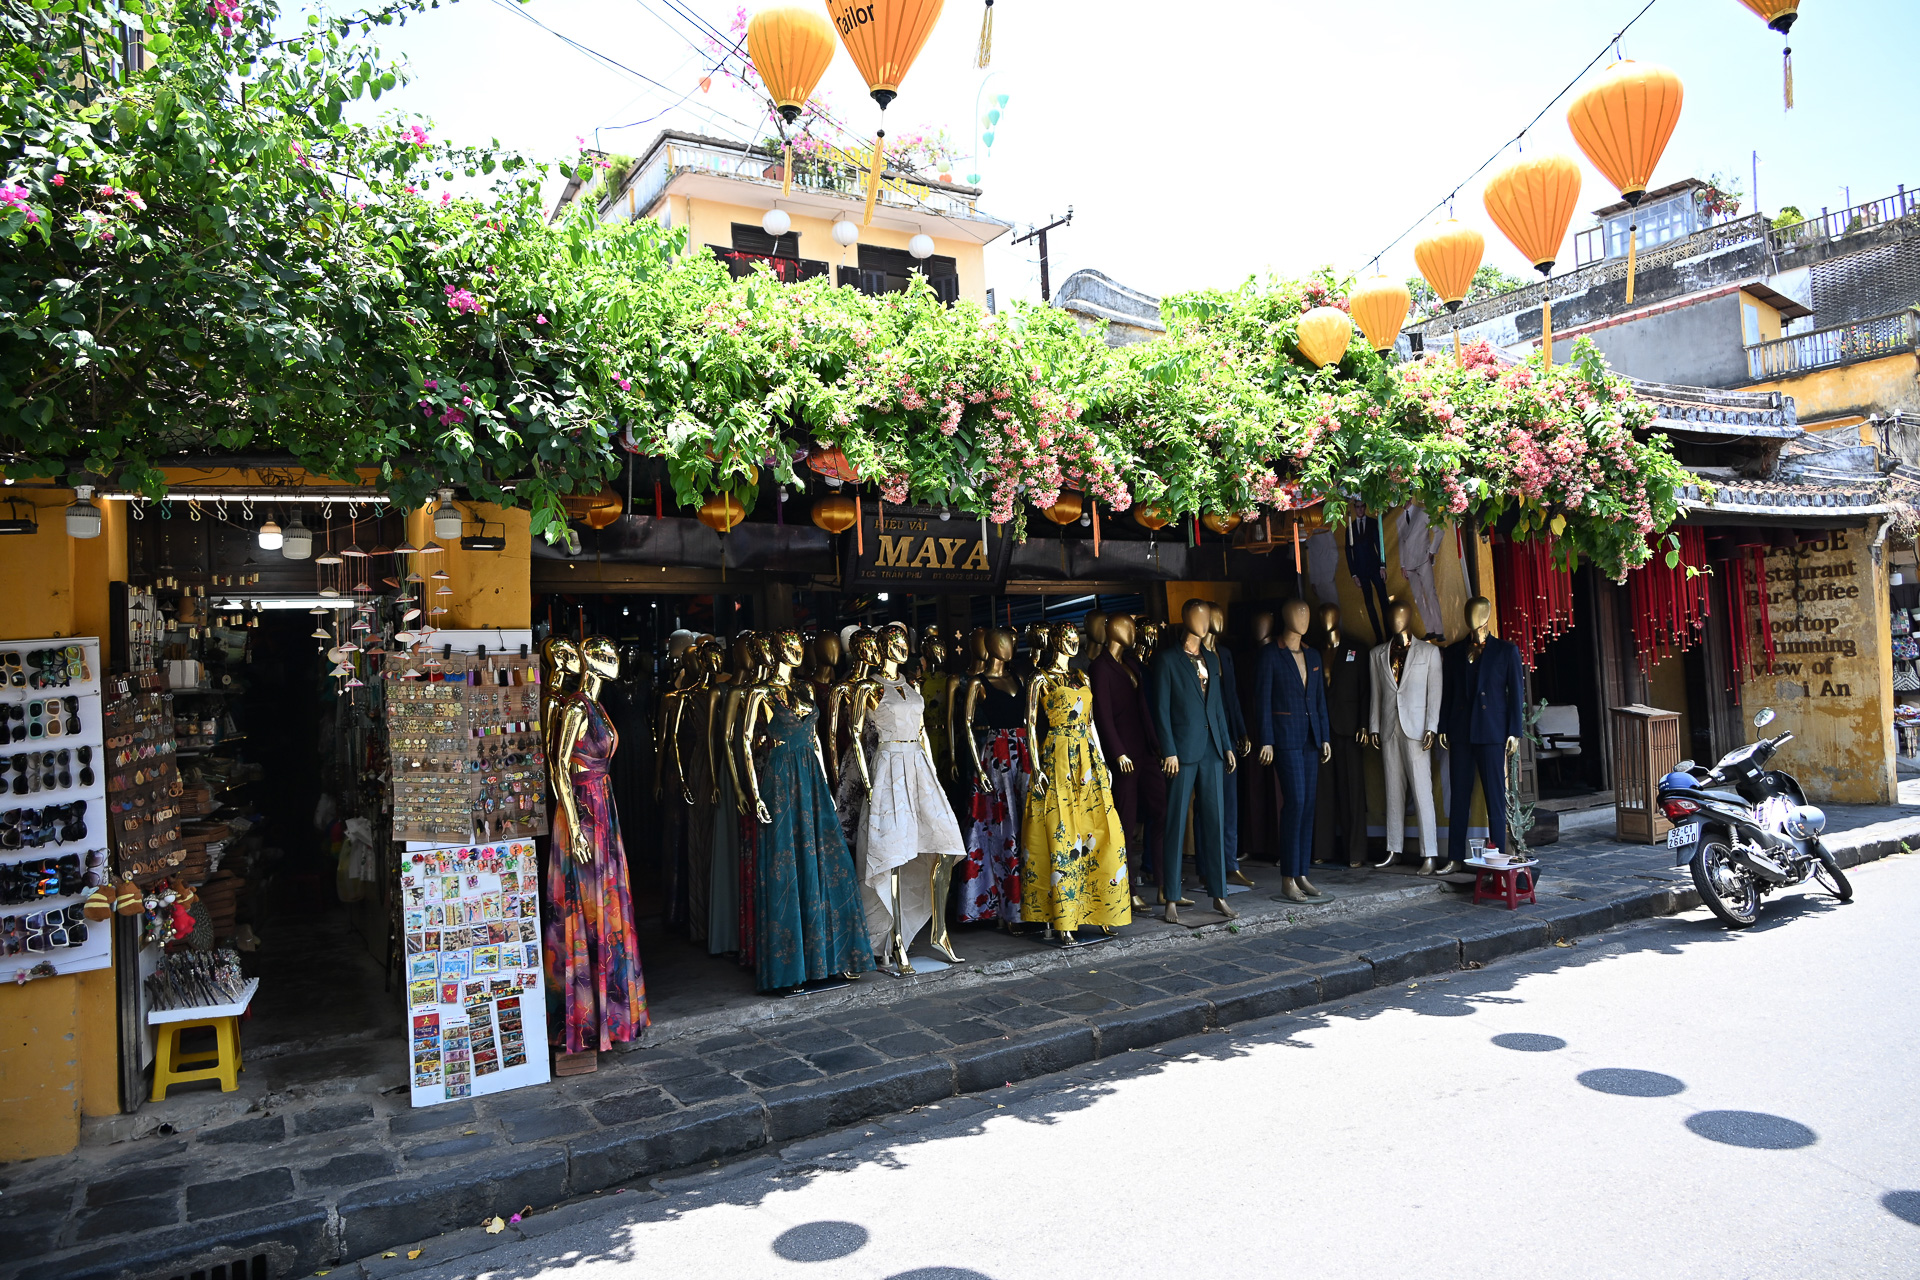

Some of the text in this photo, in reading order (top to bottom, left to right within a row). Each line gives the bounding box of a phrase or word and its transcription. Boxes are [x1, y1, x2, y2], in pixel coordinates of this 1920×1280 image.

[836, 4, 875, 39] Tailor
[874, 534, 990, 570] MAYA
[1753, 657, 1835, 677] vew of
[1819, 680, 1852, 697] An
[1669, 833, 1696, 848] 266.70
